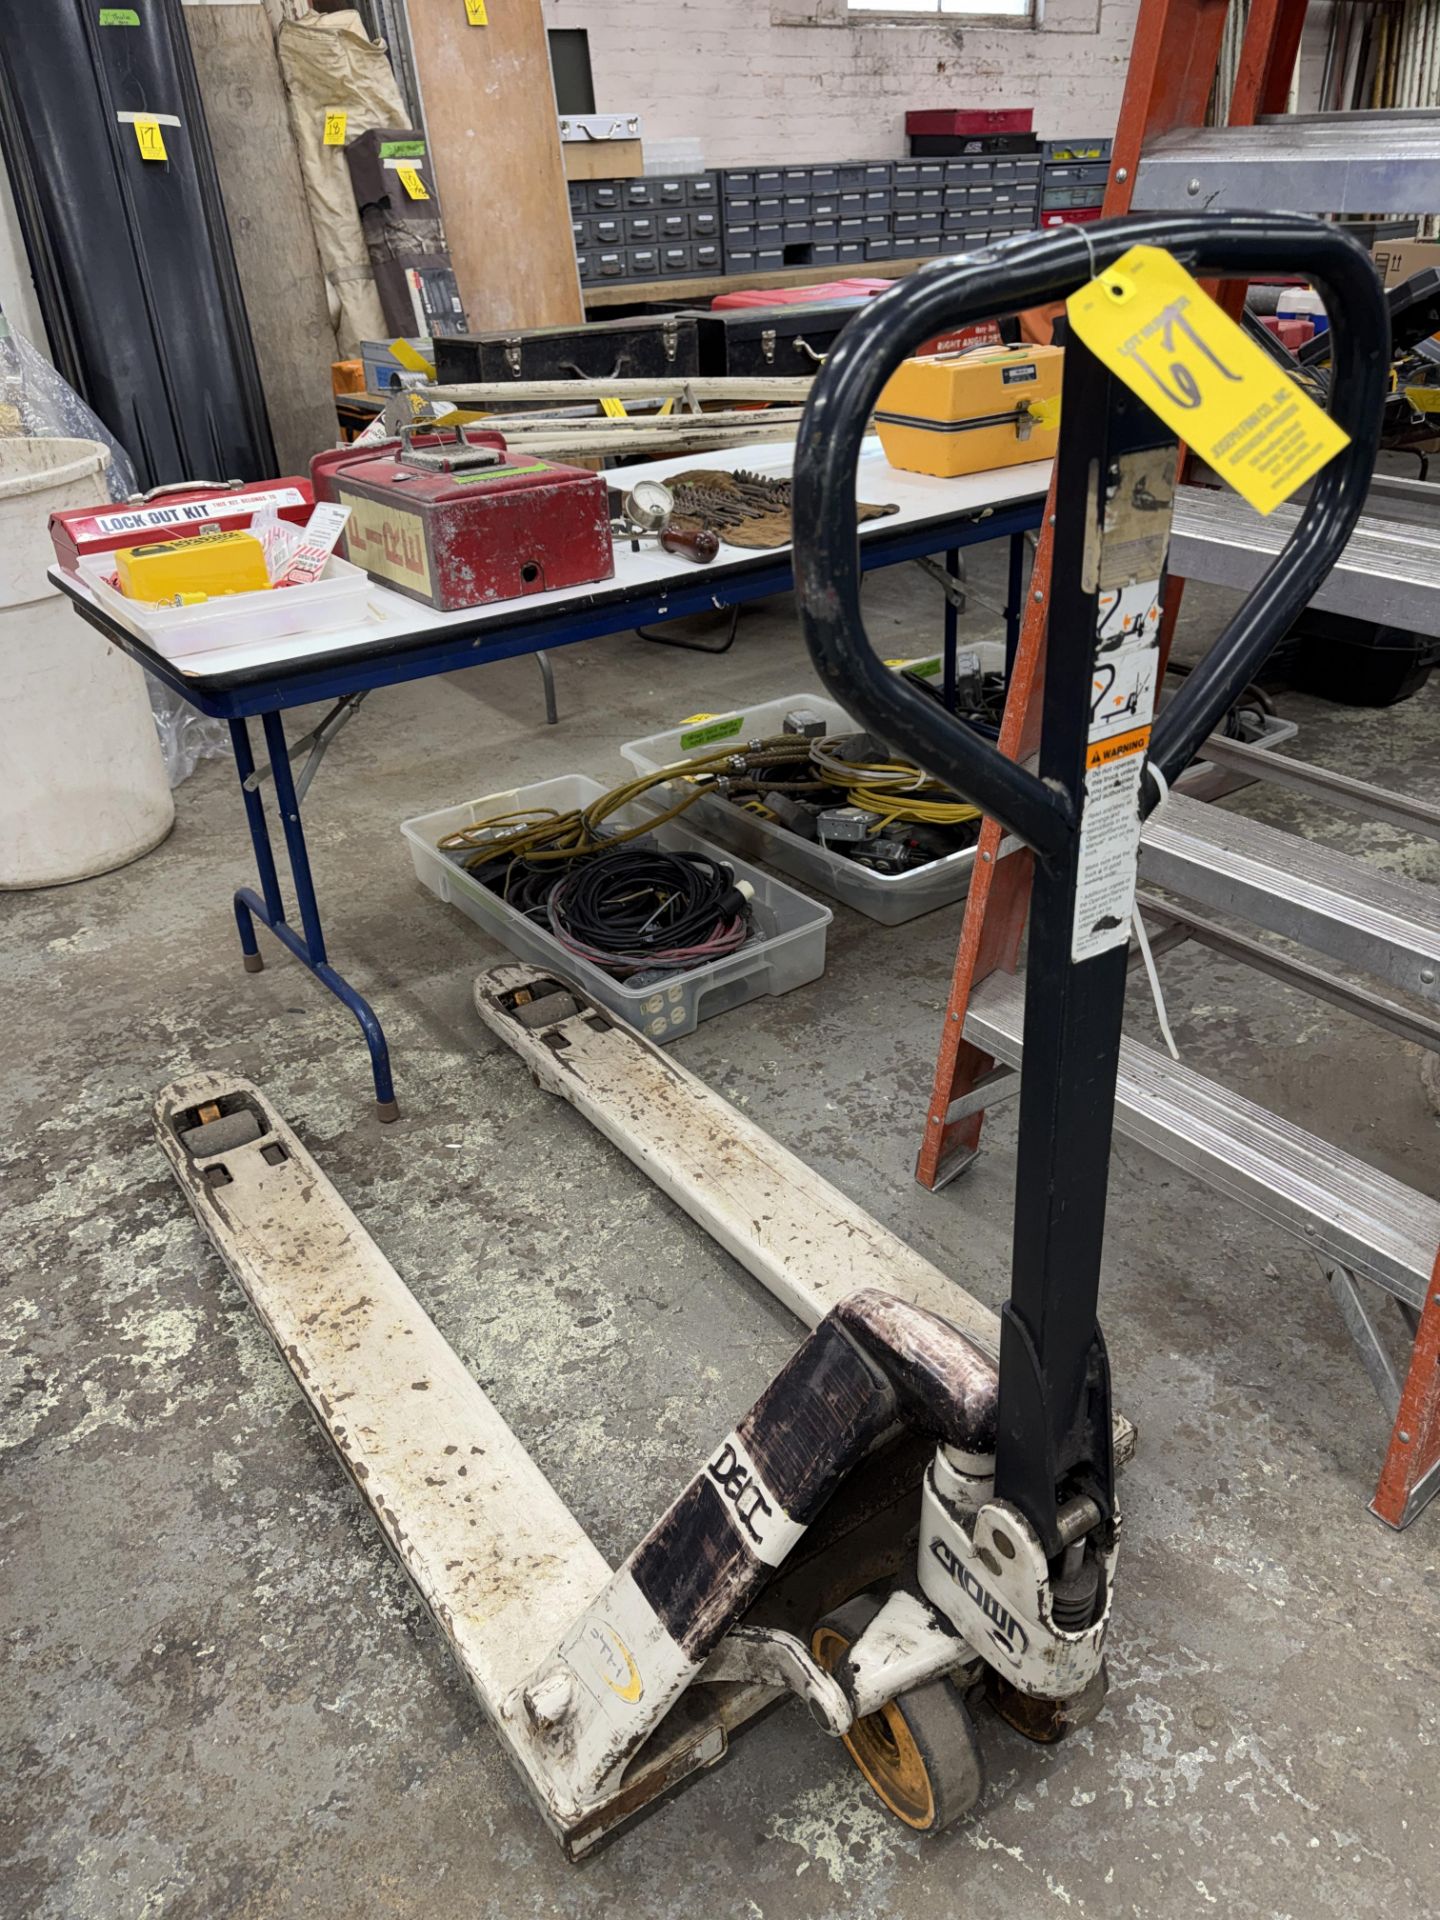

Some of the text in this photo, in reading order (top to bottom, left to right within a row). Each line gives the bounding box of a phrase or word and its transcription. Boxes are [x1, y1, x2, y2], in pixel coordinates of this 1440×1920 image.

[139, 127, 156, 149] 17
[937, 338, 962, 351] RIGHT
[1130, 304, 1244, 410] 67
[100, 504, 211, 533] LOCK OUT KIT
[1103, 738, 1145, 758] WARNING
